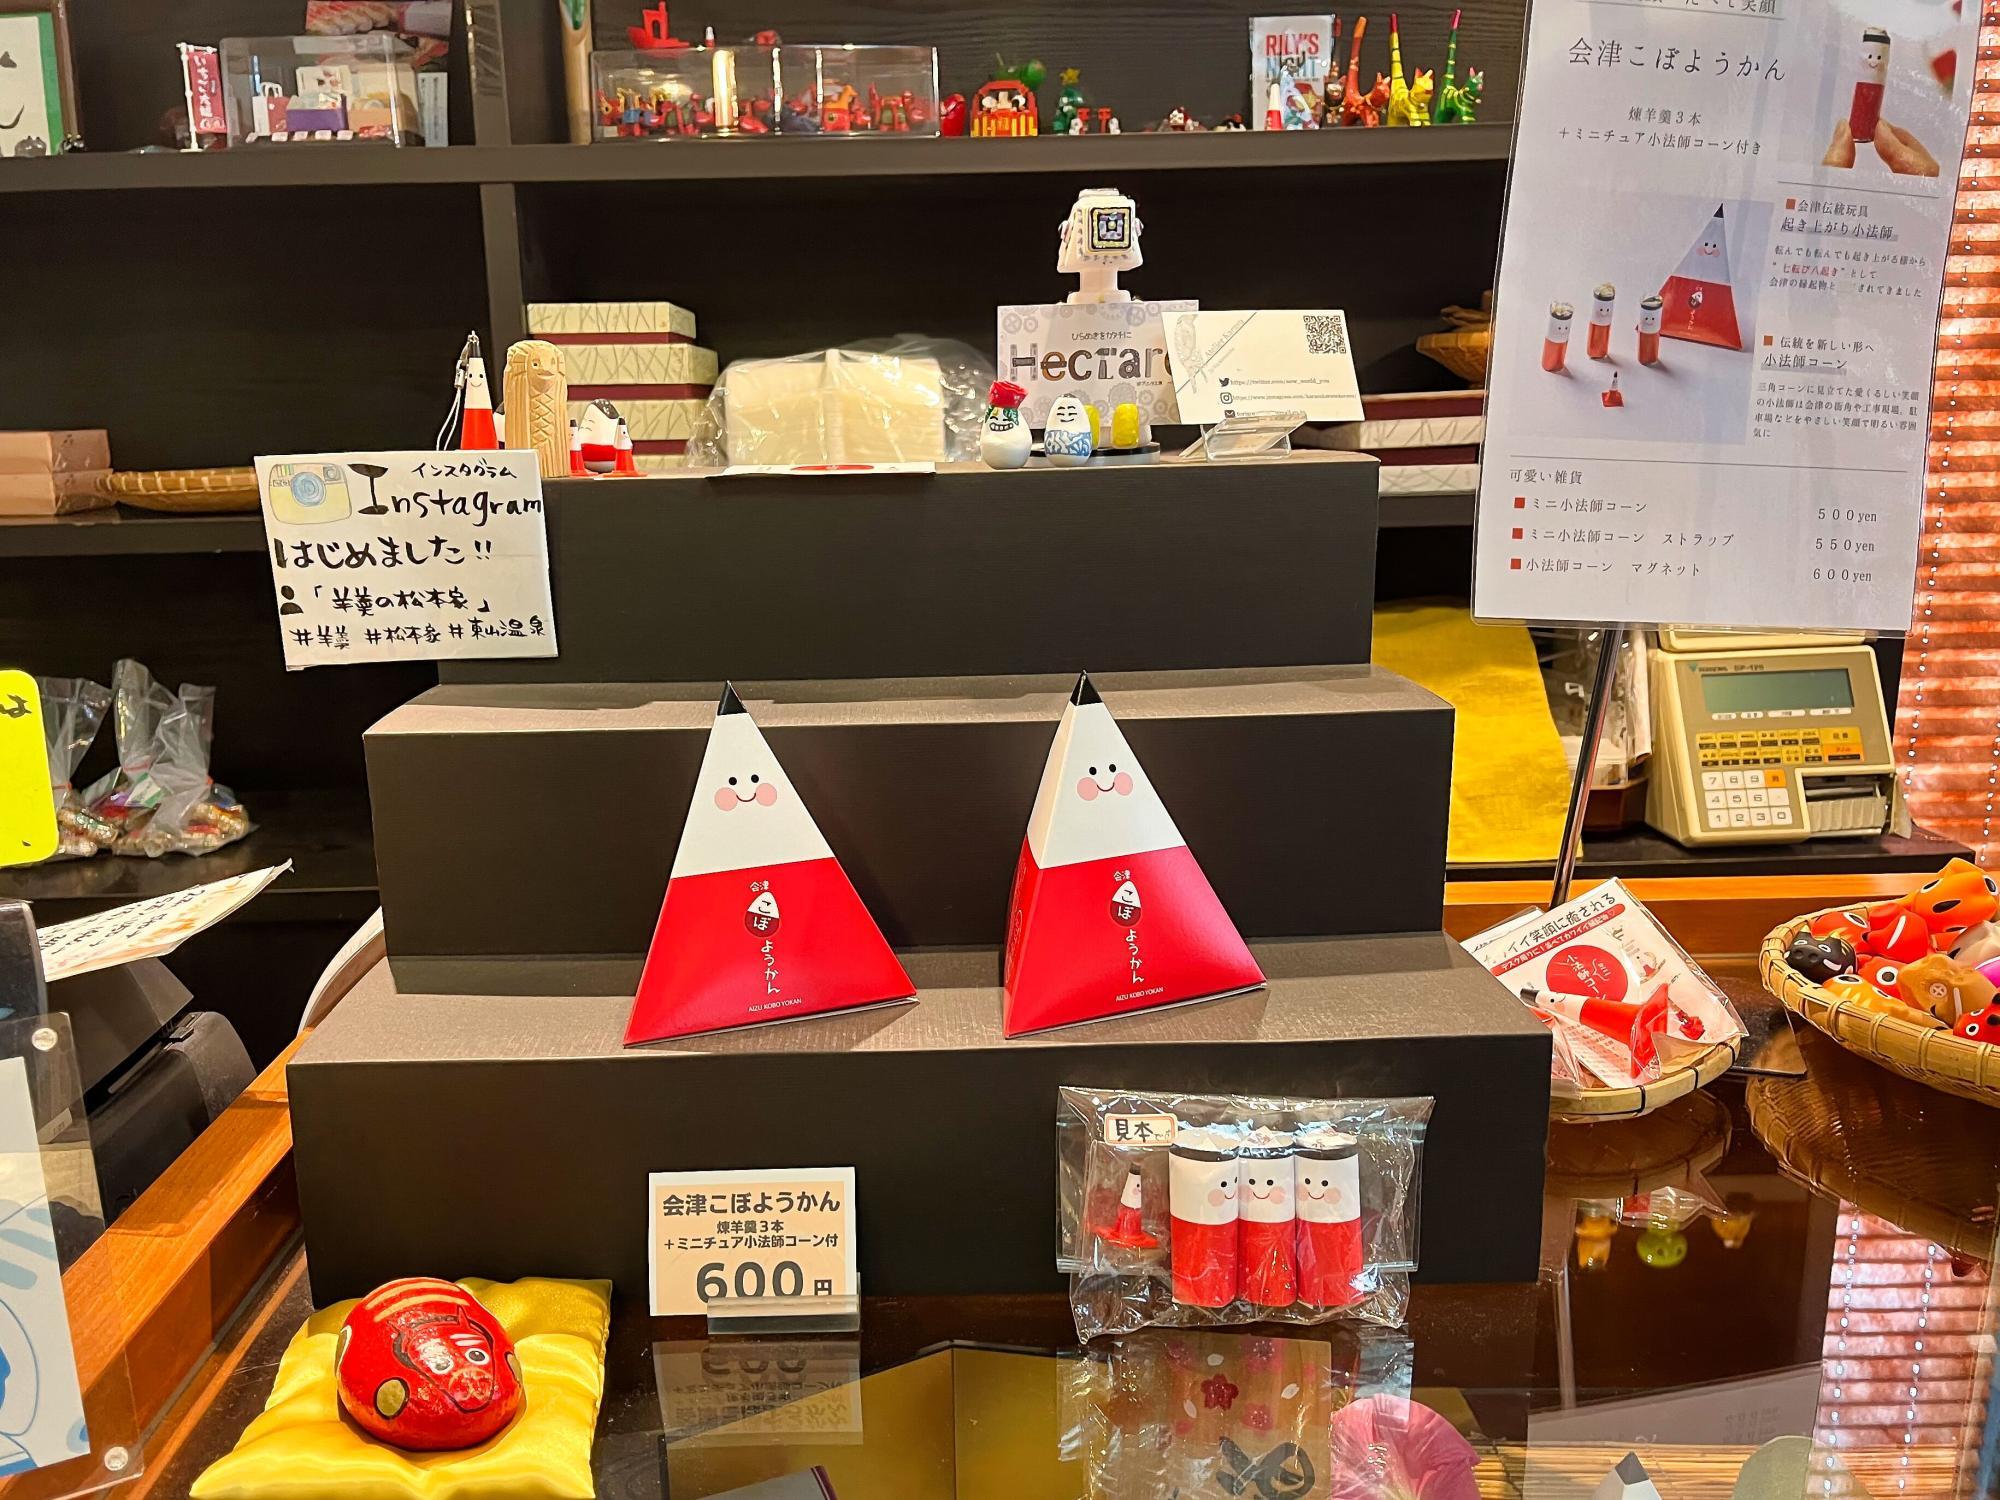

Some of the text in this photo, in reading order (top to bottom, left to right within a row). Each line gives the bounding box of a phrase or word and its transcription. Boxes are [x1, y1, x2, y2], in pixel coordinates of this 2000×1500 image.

[1568, 37, 1786, 81] 会津こぼようかん
[1797, 199, 1869, 218] 会津伝統玩具
[1781, 216, 1893, 240] 起き上がり小法師
[1780, 336, 1875, 353] 伝統を新しい形へ
[1763, 353, 1848, 369] 小法師コーン
[411, 457, 518, 480] インスタグラム
[1509, 468, 1583, 486] 可愛い雑貨
[347, 463, 542, 526] Instagram
[1531, 497, 1648, 514] ミニ小法師コーン
[1529, 528, 1735, 547] ミニ小法師コーン ストラップ
[273, 536, 493, 569] はじめました!!
[1526, 558, 1701, 577] 小法師コーン マグネット
[662, 1191, 841, 1216] 会津こぼようかん
[664, 1233, 838, 1250] ＋ミニチュア小法師コーン付
